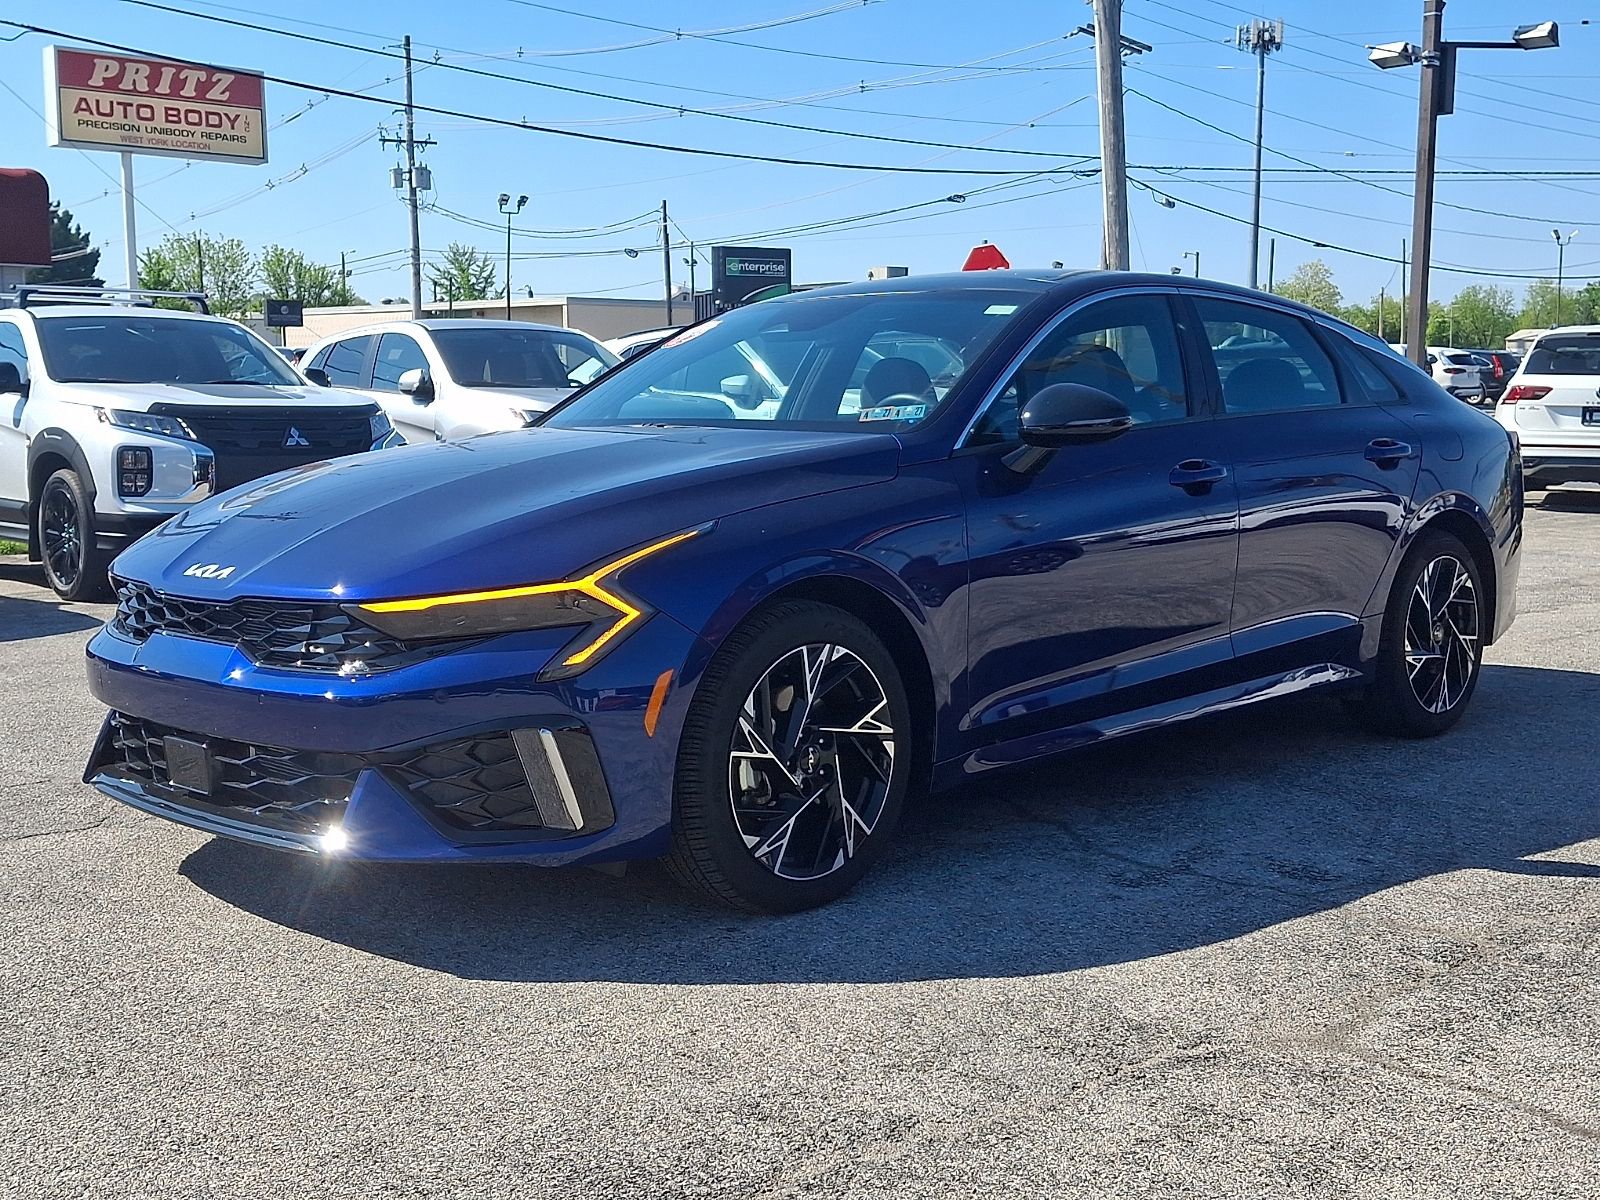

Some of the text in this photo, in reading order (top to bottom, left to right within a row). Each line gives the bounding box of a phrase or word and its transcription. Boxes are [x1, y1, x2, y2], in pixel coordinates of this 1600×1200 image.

[87, 58, 235, 101] PRITZ
[73, 97, 241, 131] AUTO BODY
[77, 118, 248, 144] PRECISION UNIBODY REPAIRS
[119, 134, 211, 151] WEST YORK LOCATION
[728, 261, 785, 274] enterprise
[183, 562, 237, 580] KIA
